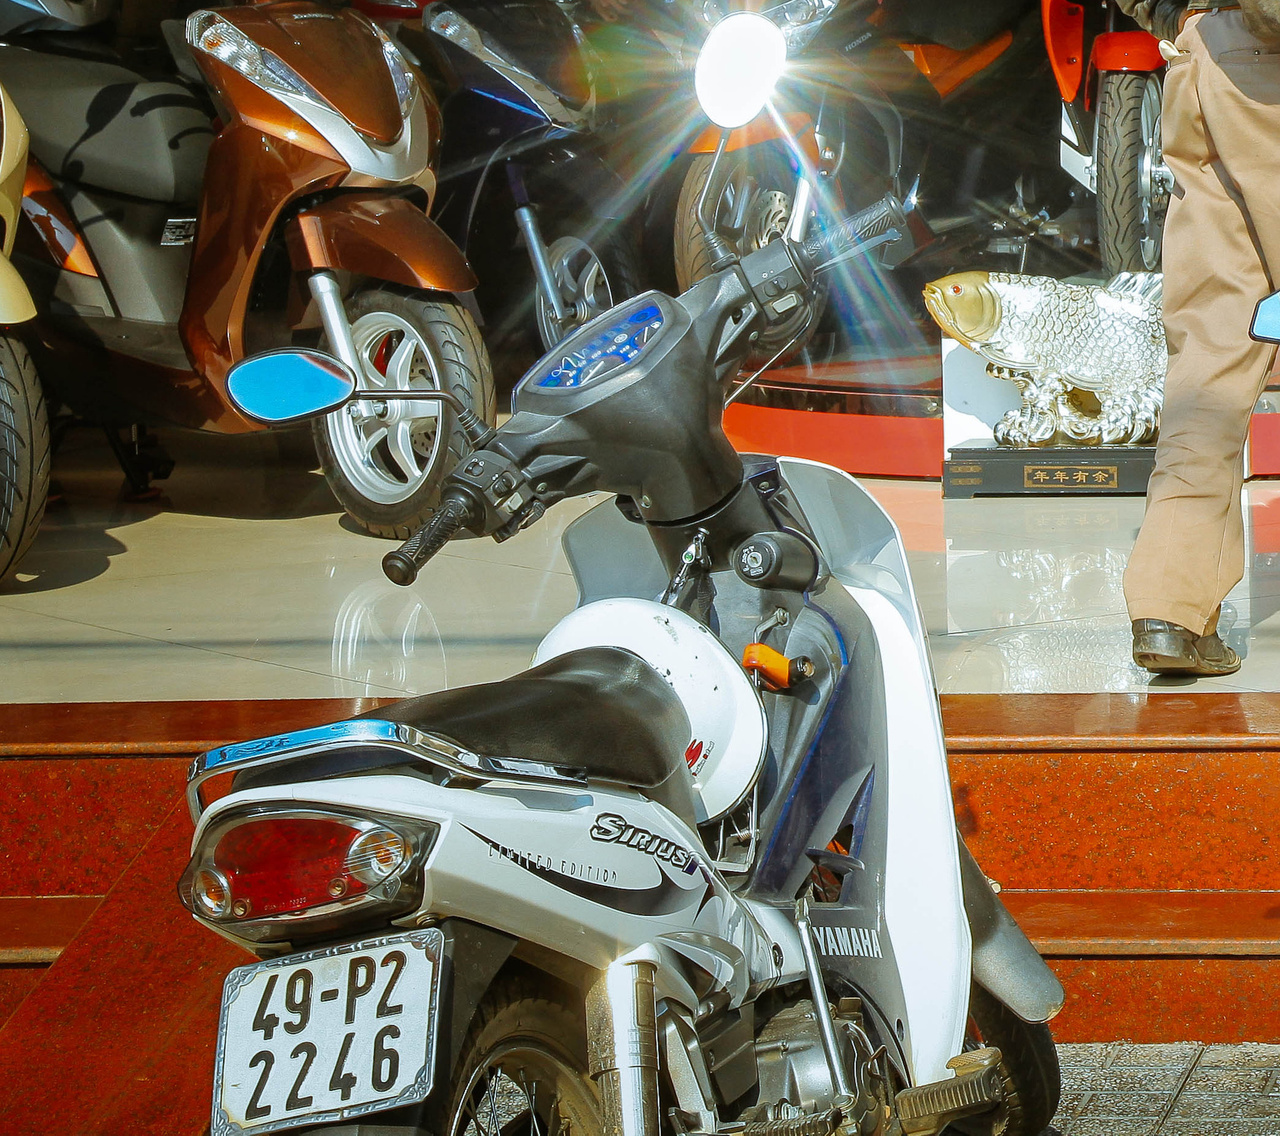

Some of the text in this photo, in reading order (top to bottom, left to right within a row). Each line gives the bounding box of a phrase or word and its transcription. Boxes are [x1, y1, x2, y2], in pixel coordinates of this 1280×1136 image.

[1032, 470, 1110, 484] 年年有余
[812, 926, 883, 959] YAMAHA
[251, 949, 408, 1042] 49-P2
[244, 1024, 401, 1122] 2246
